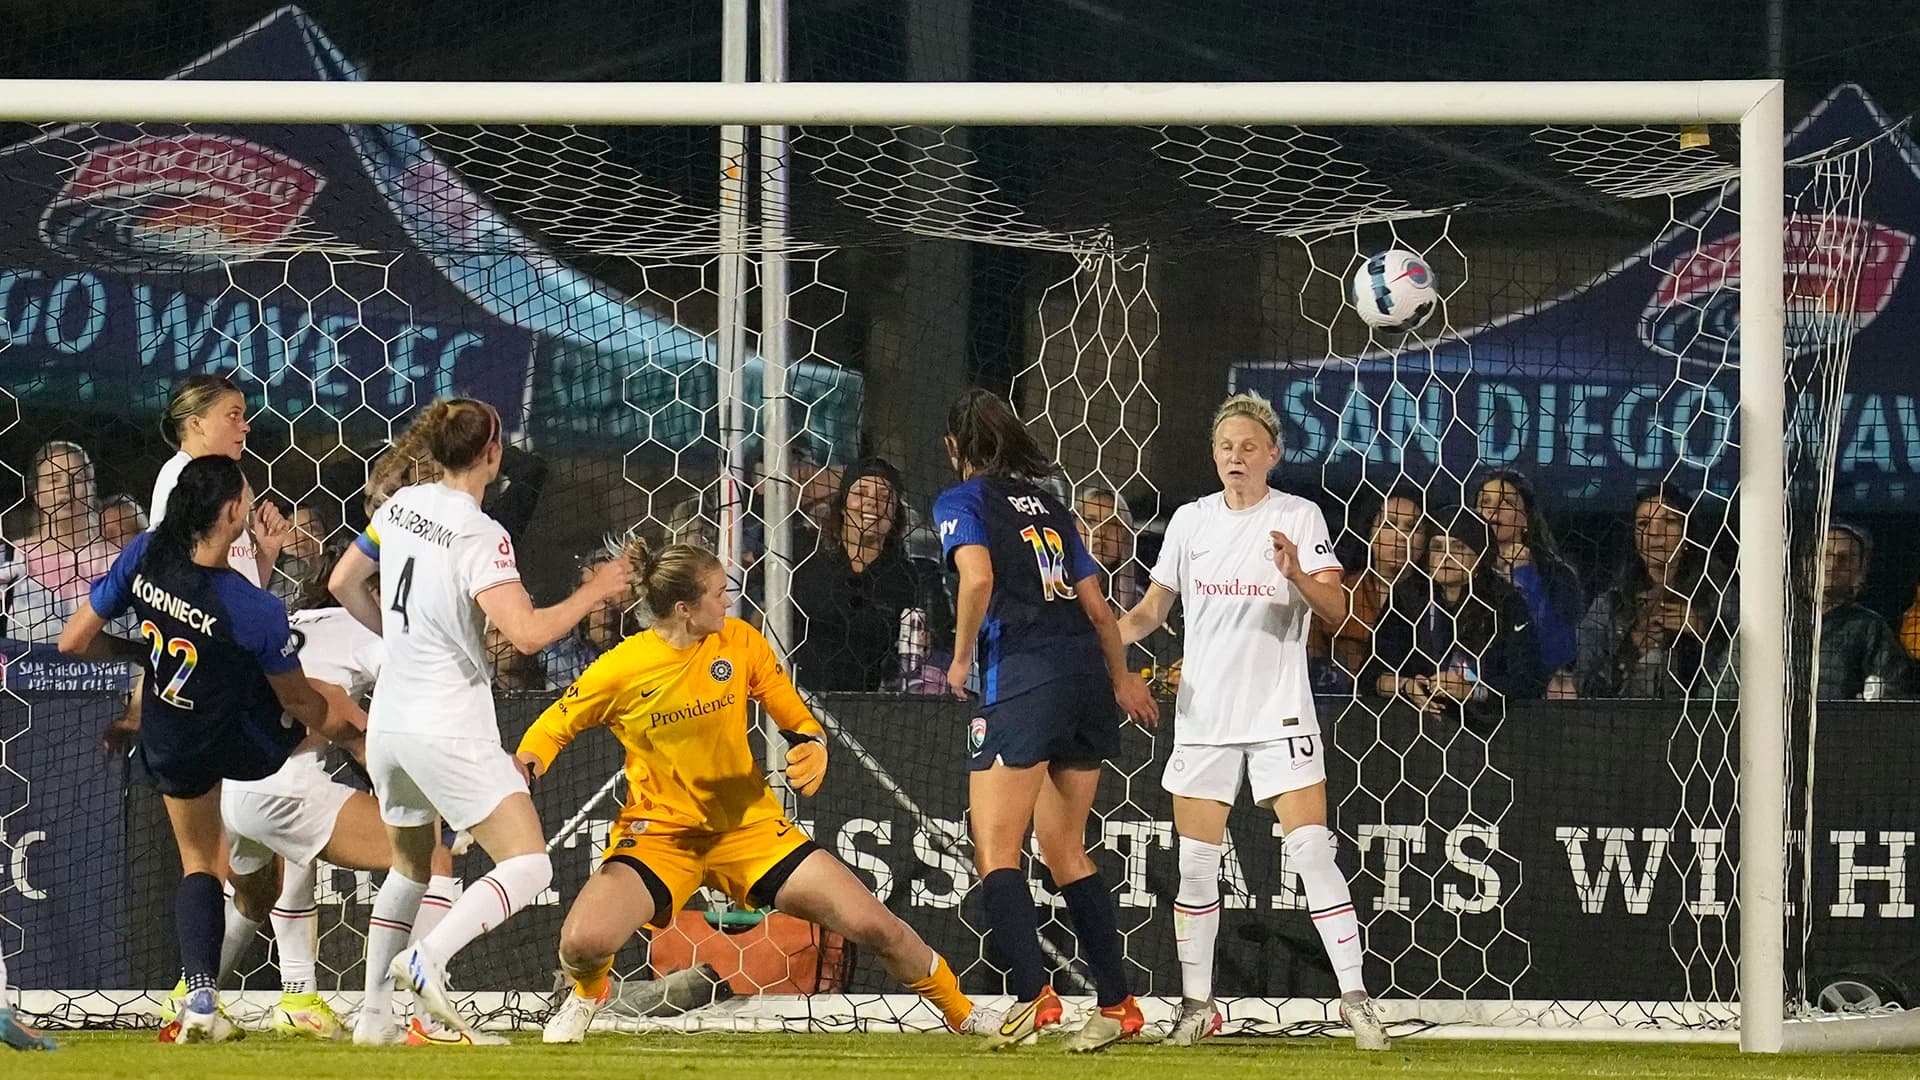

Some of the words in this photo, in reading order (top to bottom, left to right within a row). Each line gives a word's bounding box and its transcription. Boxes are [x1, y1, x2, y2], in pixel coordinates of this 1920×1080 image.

[135, 283, 358, 398] WAVE
[387, 322, 486, 406] FC
[1283, 379, 1445, 467] SAN
[1477, 382, 1732, 470] DIEGO
[131, 573, 218, 638] KORNIECK
[391, 556, 415, 634] 4
[1194, 578, 1276, 598] Providence
[18, 661, 45, 677] SAN
[90, 661, 128, 677] WAVE
[650, 693, 735, 728] Providence
[1555, 826, 1916, 918] WIH
